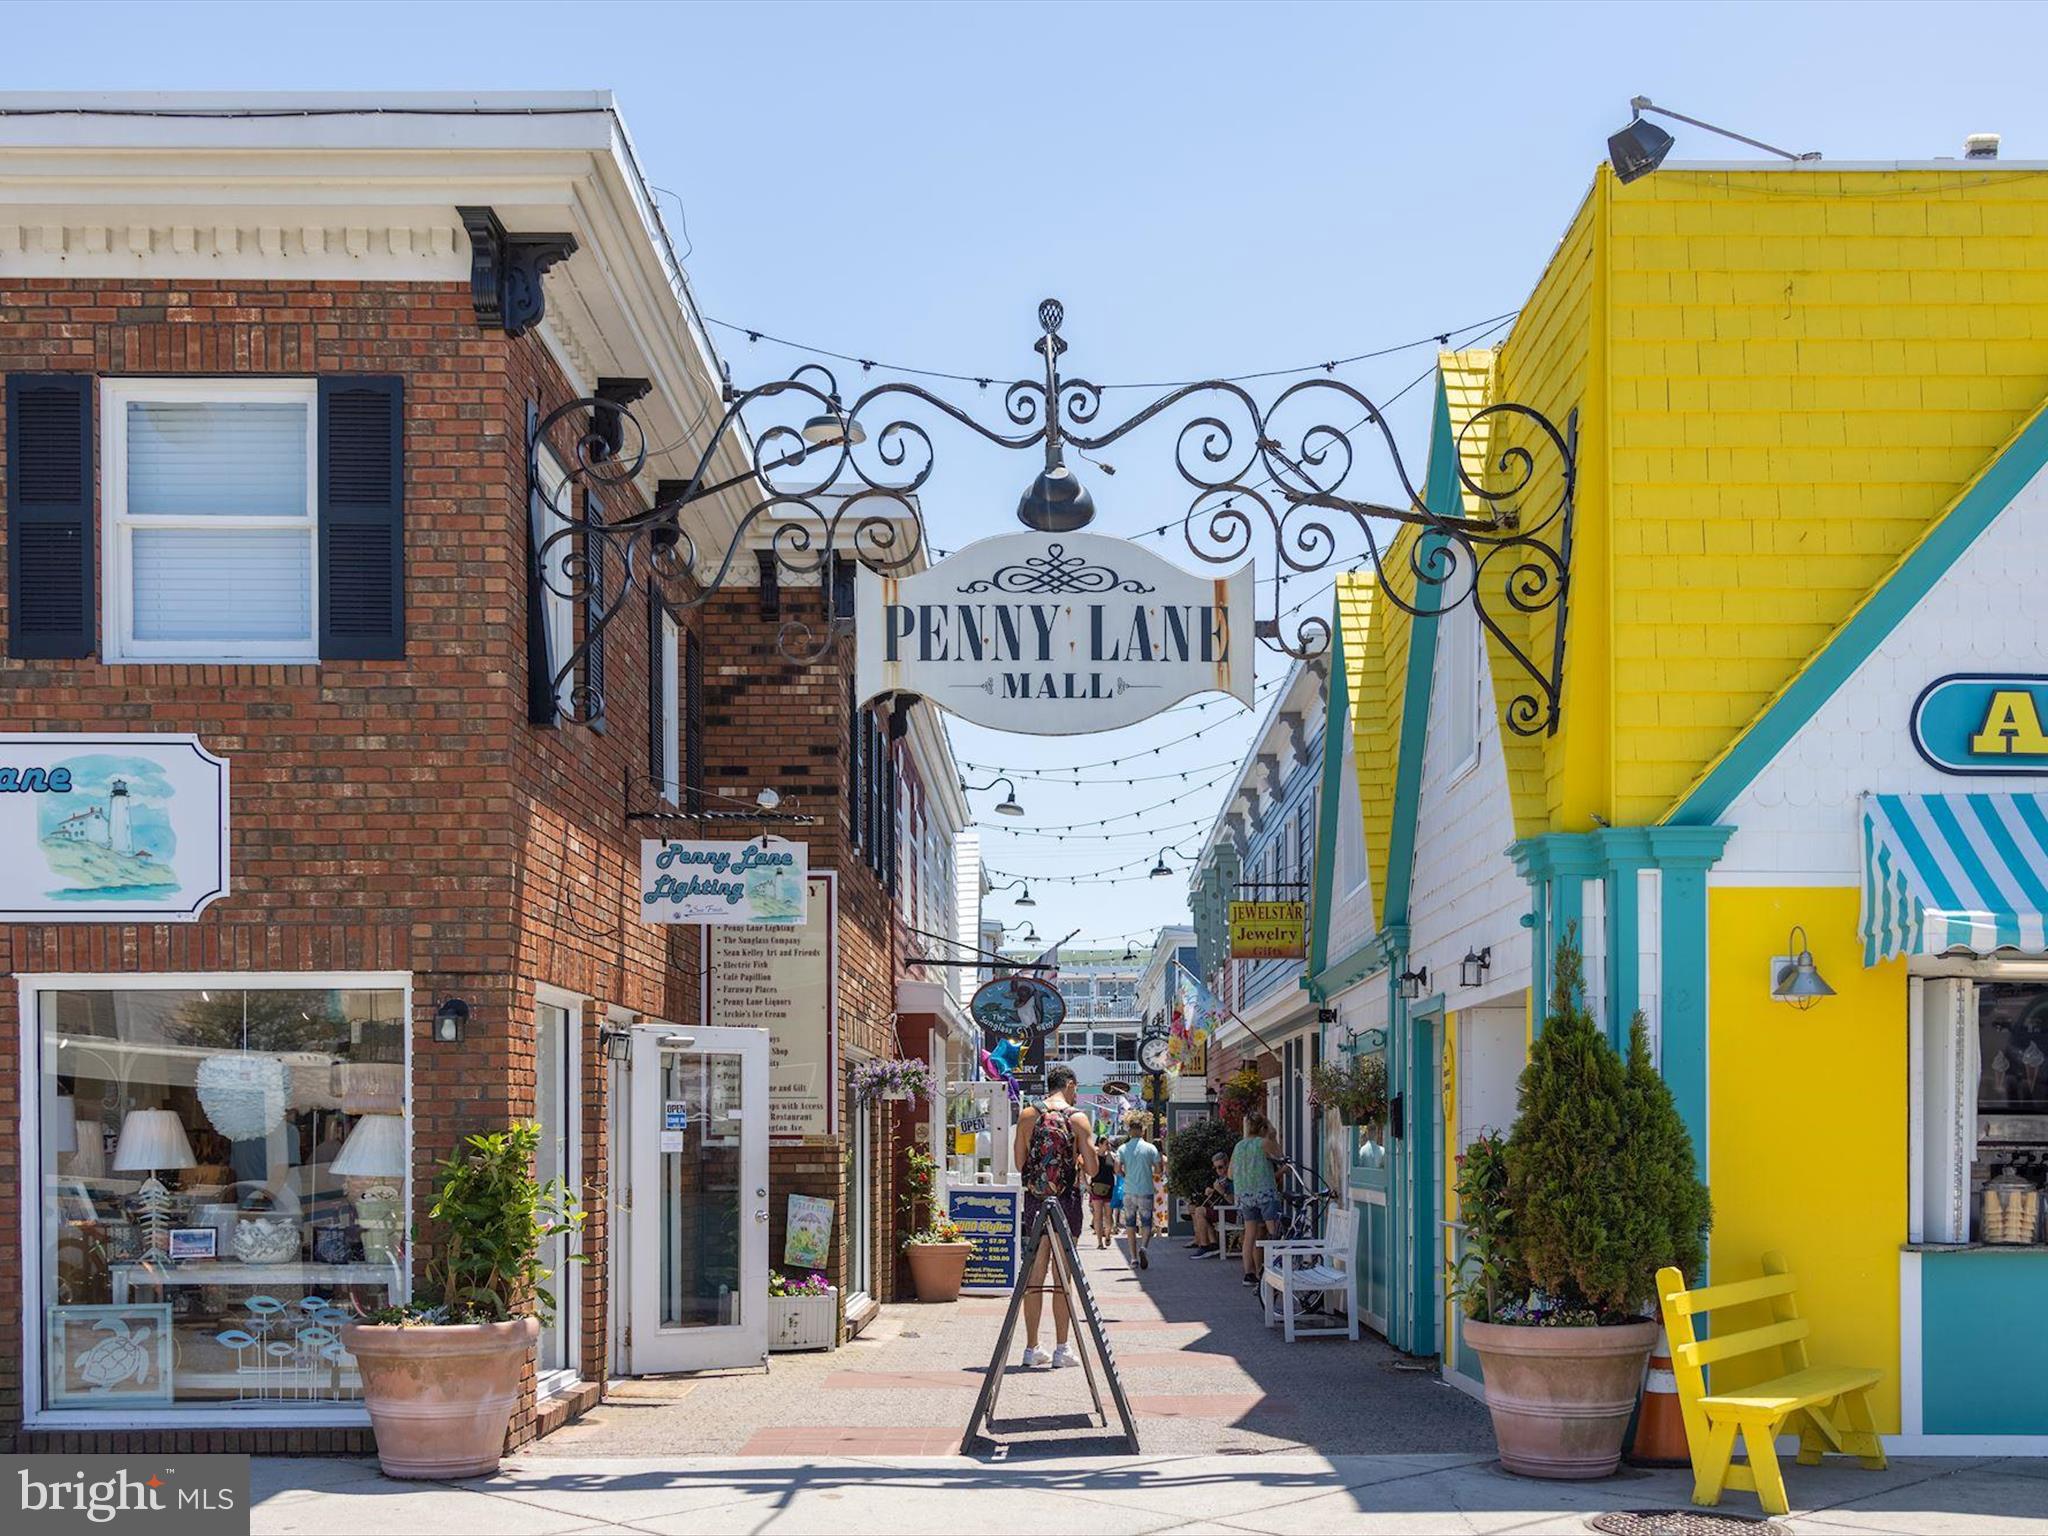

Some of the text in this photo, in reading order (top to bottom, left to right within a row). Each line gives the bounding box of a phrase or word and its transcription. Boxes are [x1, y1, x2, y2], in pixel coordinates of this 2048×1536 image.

[883, 604, 1230, 662] PENNY LANE
[1002, 672, 1113, 699] MALL
[655, 843, 793, 875] Penny Lane
[643, 873, 744, 905] Lighting
[1233, 905, 1302, 924] JEWELSTAR
[738, 937, 768, 946] Sunglass
[771, 937, 800, 946] Company
[1237, 927, 1298, 942] Jewelry
[723, 985, 777, 994] Faraway Places
[723, 998, 744, 1007] Penny
[765, 998, 791, 1007] Liquors
[752, 1010, 763, 1018] Ice
[764, 1010, 786, 1018] Cream
[992, 1013, 1006, 1021] The
[979, 1015, 1013, 1034] Sunglass
[667, 1104, 686, 1113] OPEN
[781, 1102, 798, 1110] with
[801, 1102, 824, 1110] Access
[960, 1118, 985, 1133] OPEN
